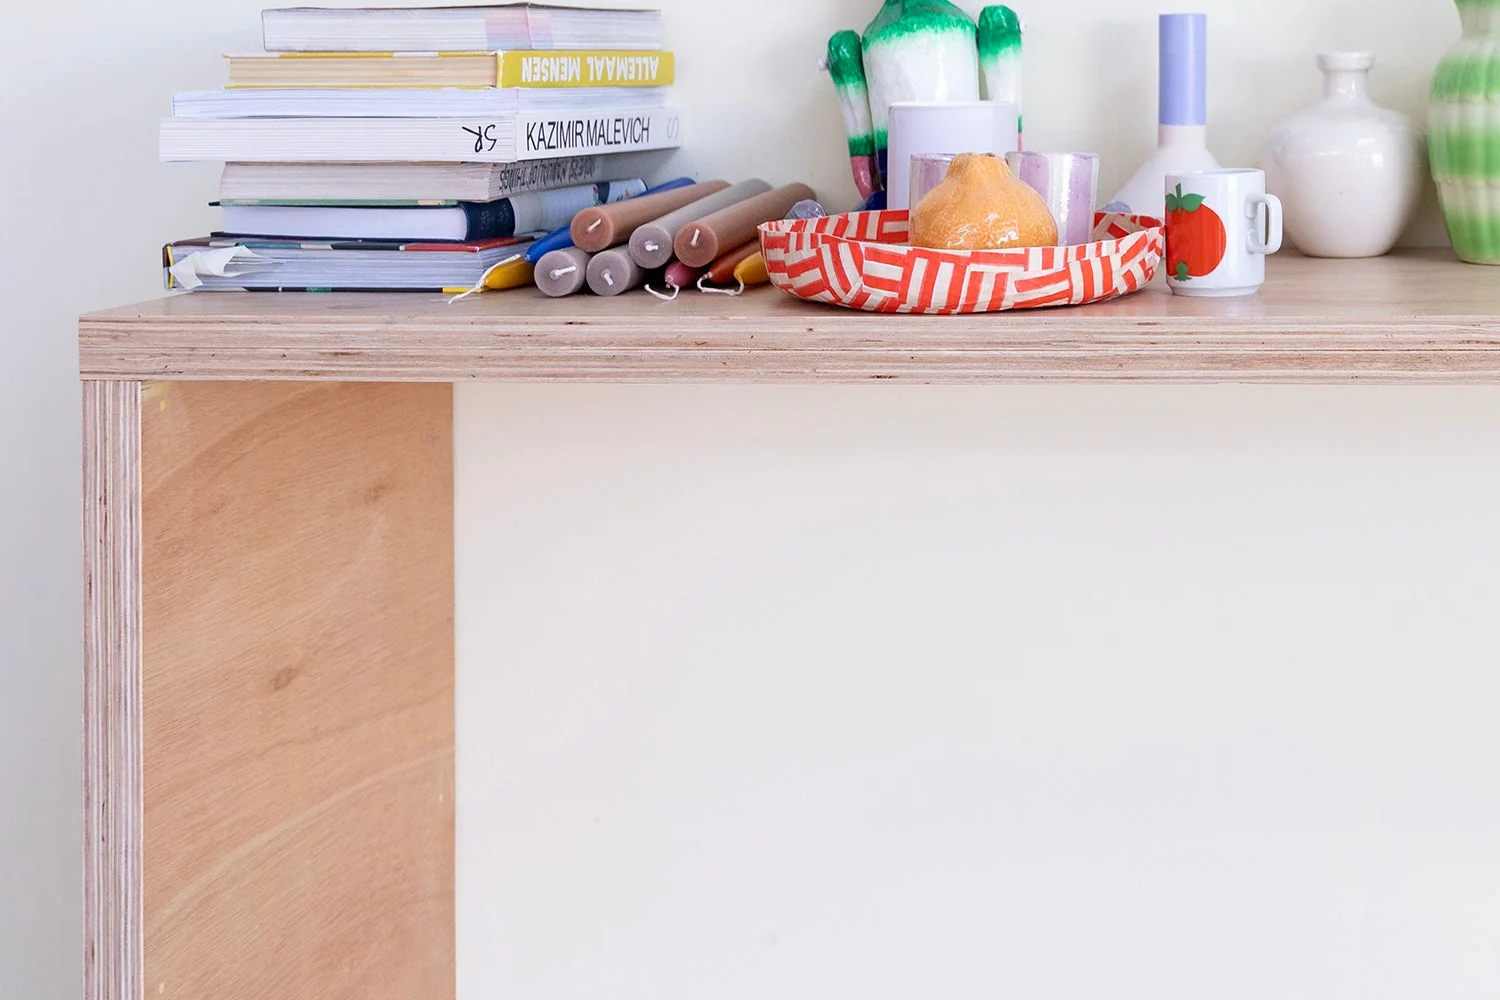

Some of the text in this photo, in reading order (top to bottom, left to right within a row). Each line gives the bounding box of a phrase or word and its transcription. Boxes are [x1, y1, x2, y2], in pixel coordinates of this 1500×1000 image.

[521, 55, 660, 83] ALLEMAAL MENSEN
[526, 116, 650, 151] KAZIMIR MALEVICH
